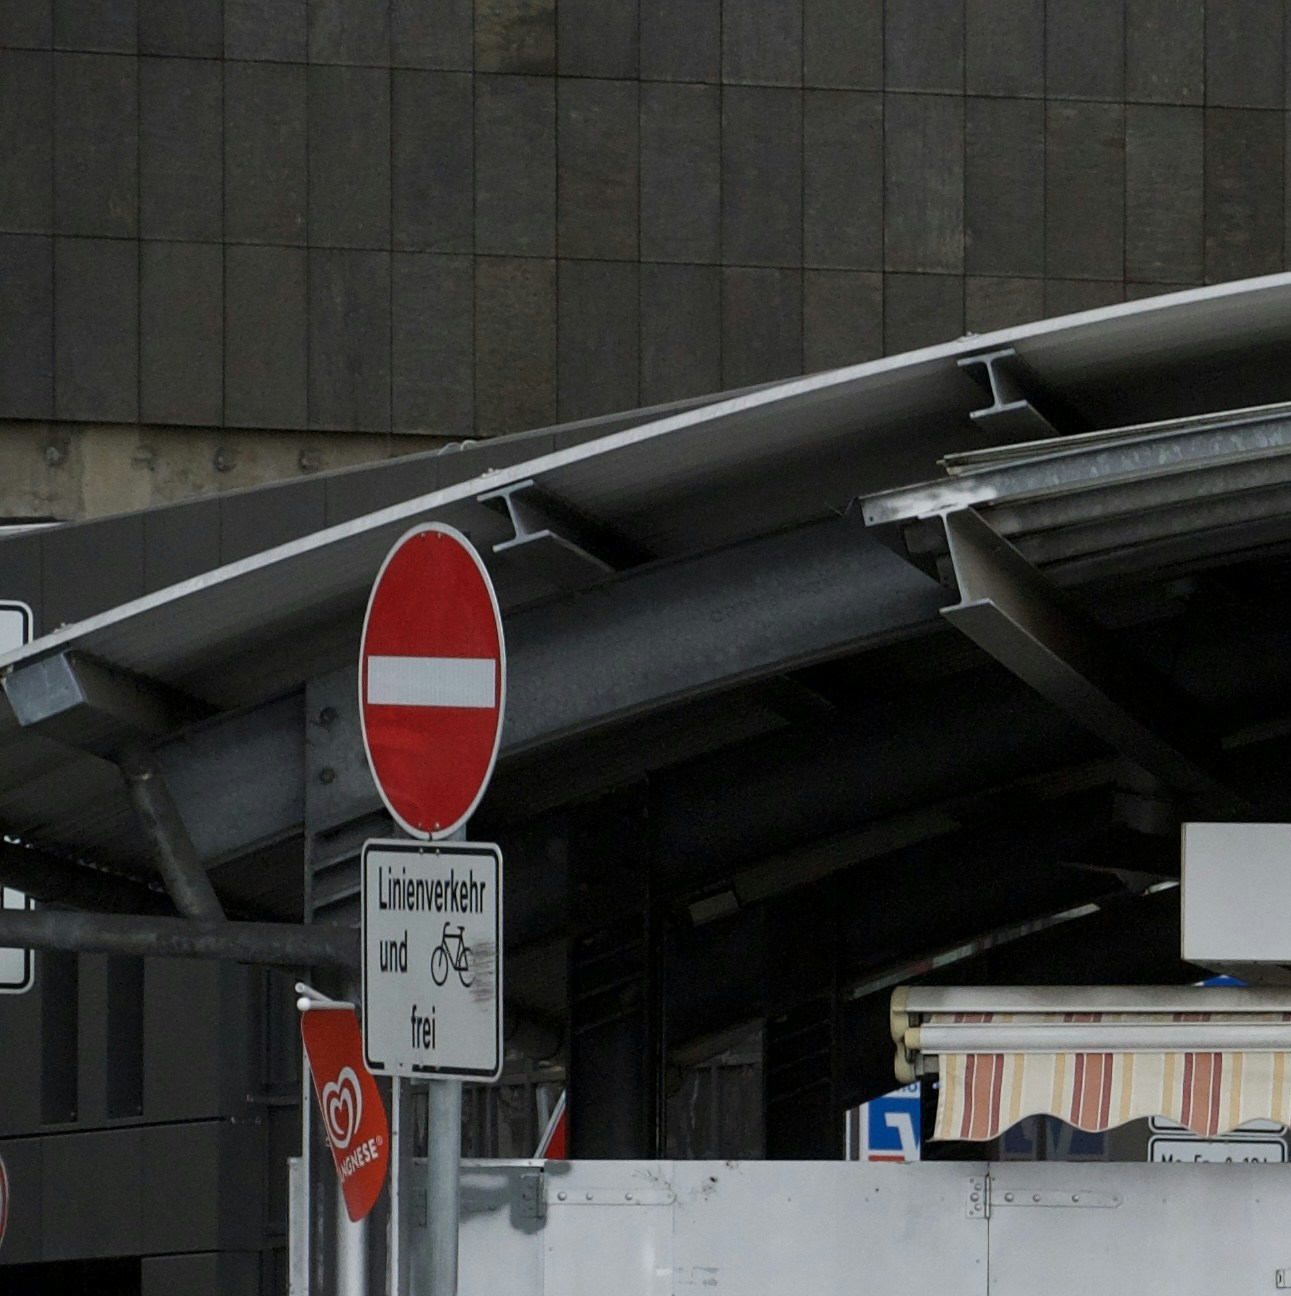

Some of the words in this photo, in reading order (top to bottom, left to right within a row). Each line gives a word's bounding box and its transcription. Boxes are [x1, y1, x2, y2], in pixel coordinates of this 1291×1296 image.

[378, 865, 486, 914] Linienverkehr
[379, 929, 408, 973] und
[410, 1004, 437, 1050] frei
